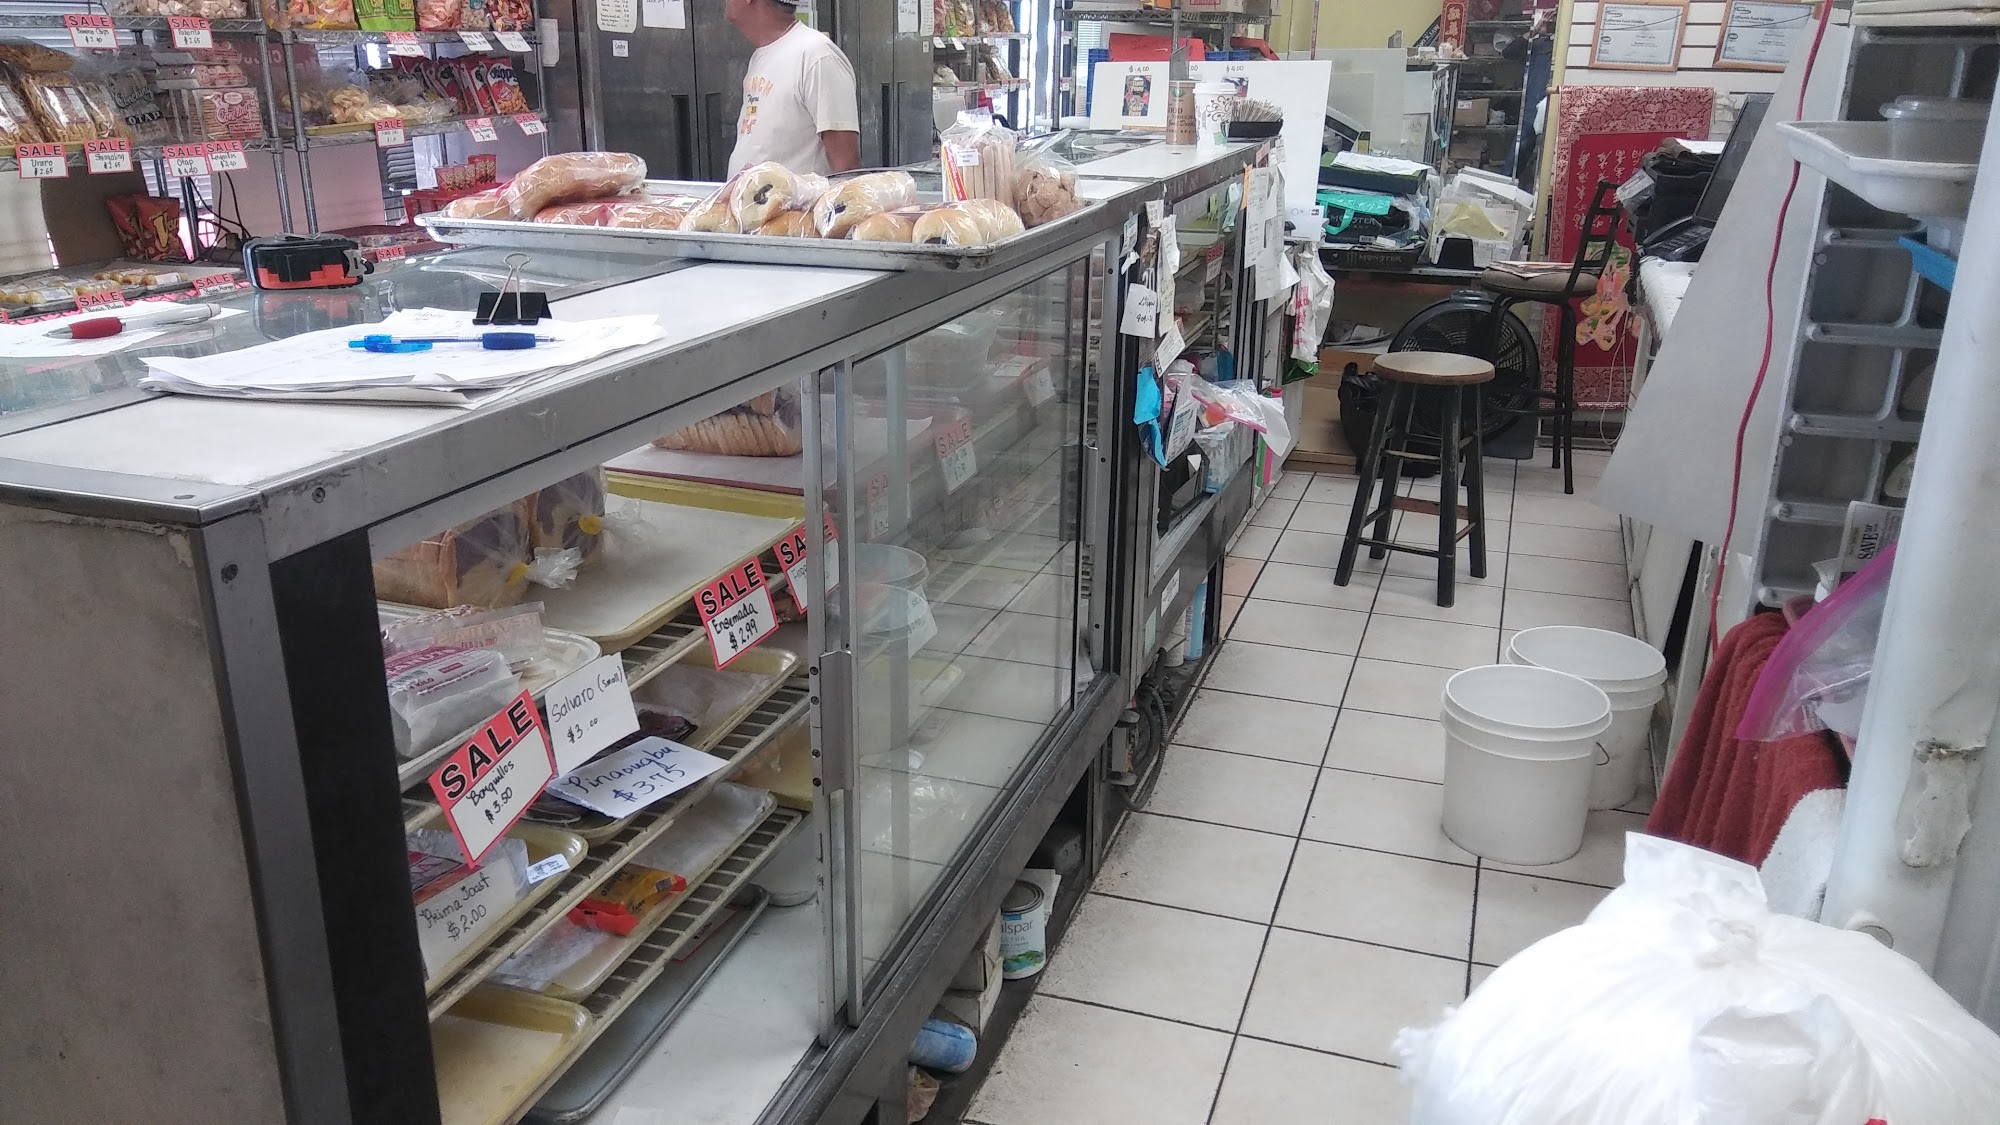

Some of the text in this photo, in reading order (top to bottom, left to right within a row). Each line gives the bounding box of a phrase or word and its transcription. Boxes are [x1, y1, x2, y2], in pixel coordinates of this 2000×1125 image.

[69, 15, 110, 27] SALE
[171, 18, 207, 29] SALE
[377, 119, 402, 129] SALE
[20, 145, 61, 157] SALE
[87, 140, 129, 152] SALE
[167, 146, 203, 158] SALE
[206, 141, 241, 153] SALE
[378, 247, 404, 258] SALE
[195, 273, 231, 288] SALE
[79, 291, 121, 307] SALE
[938, 422, 971, 455] SALE
[700, 562, 761, 616] SALE
[440, 698, 534, 800] SALE
